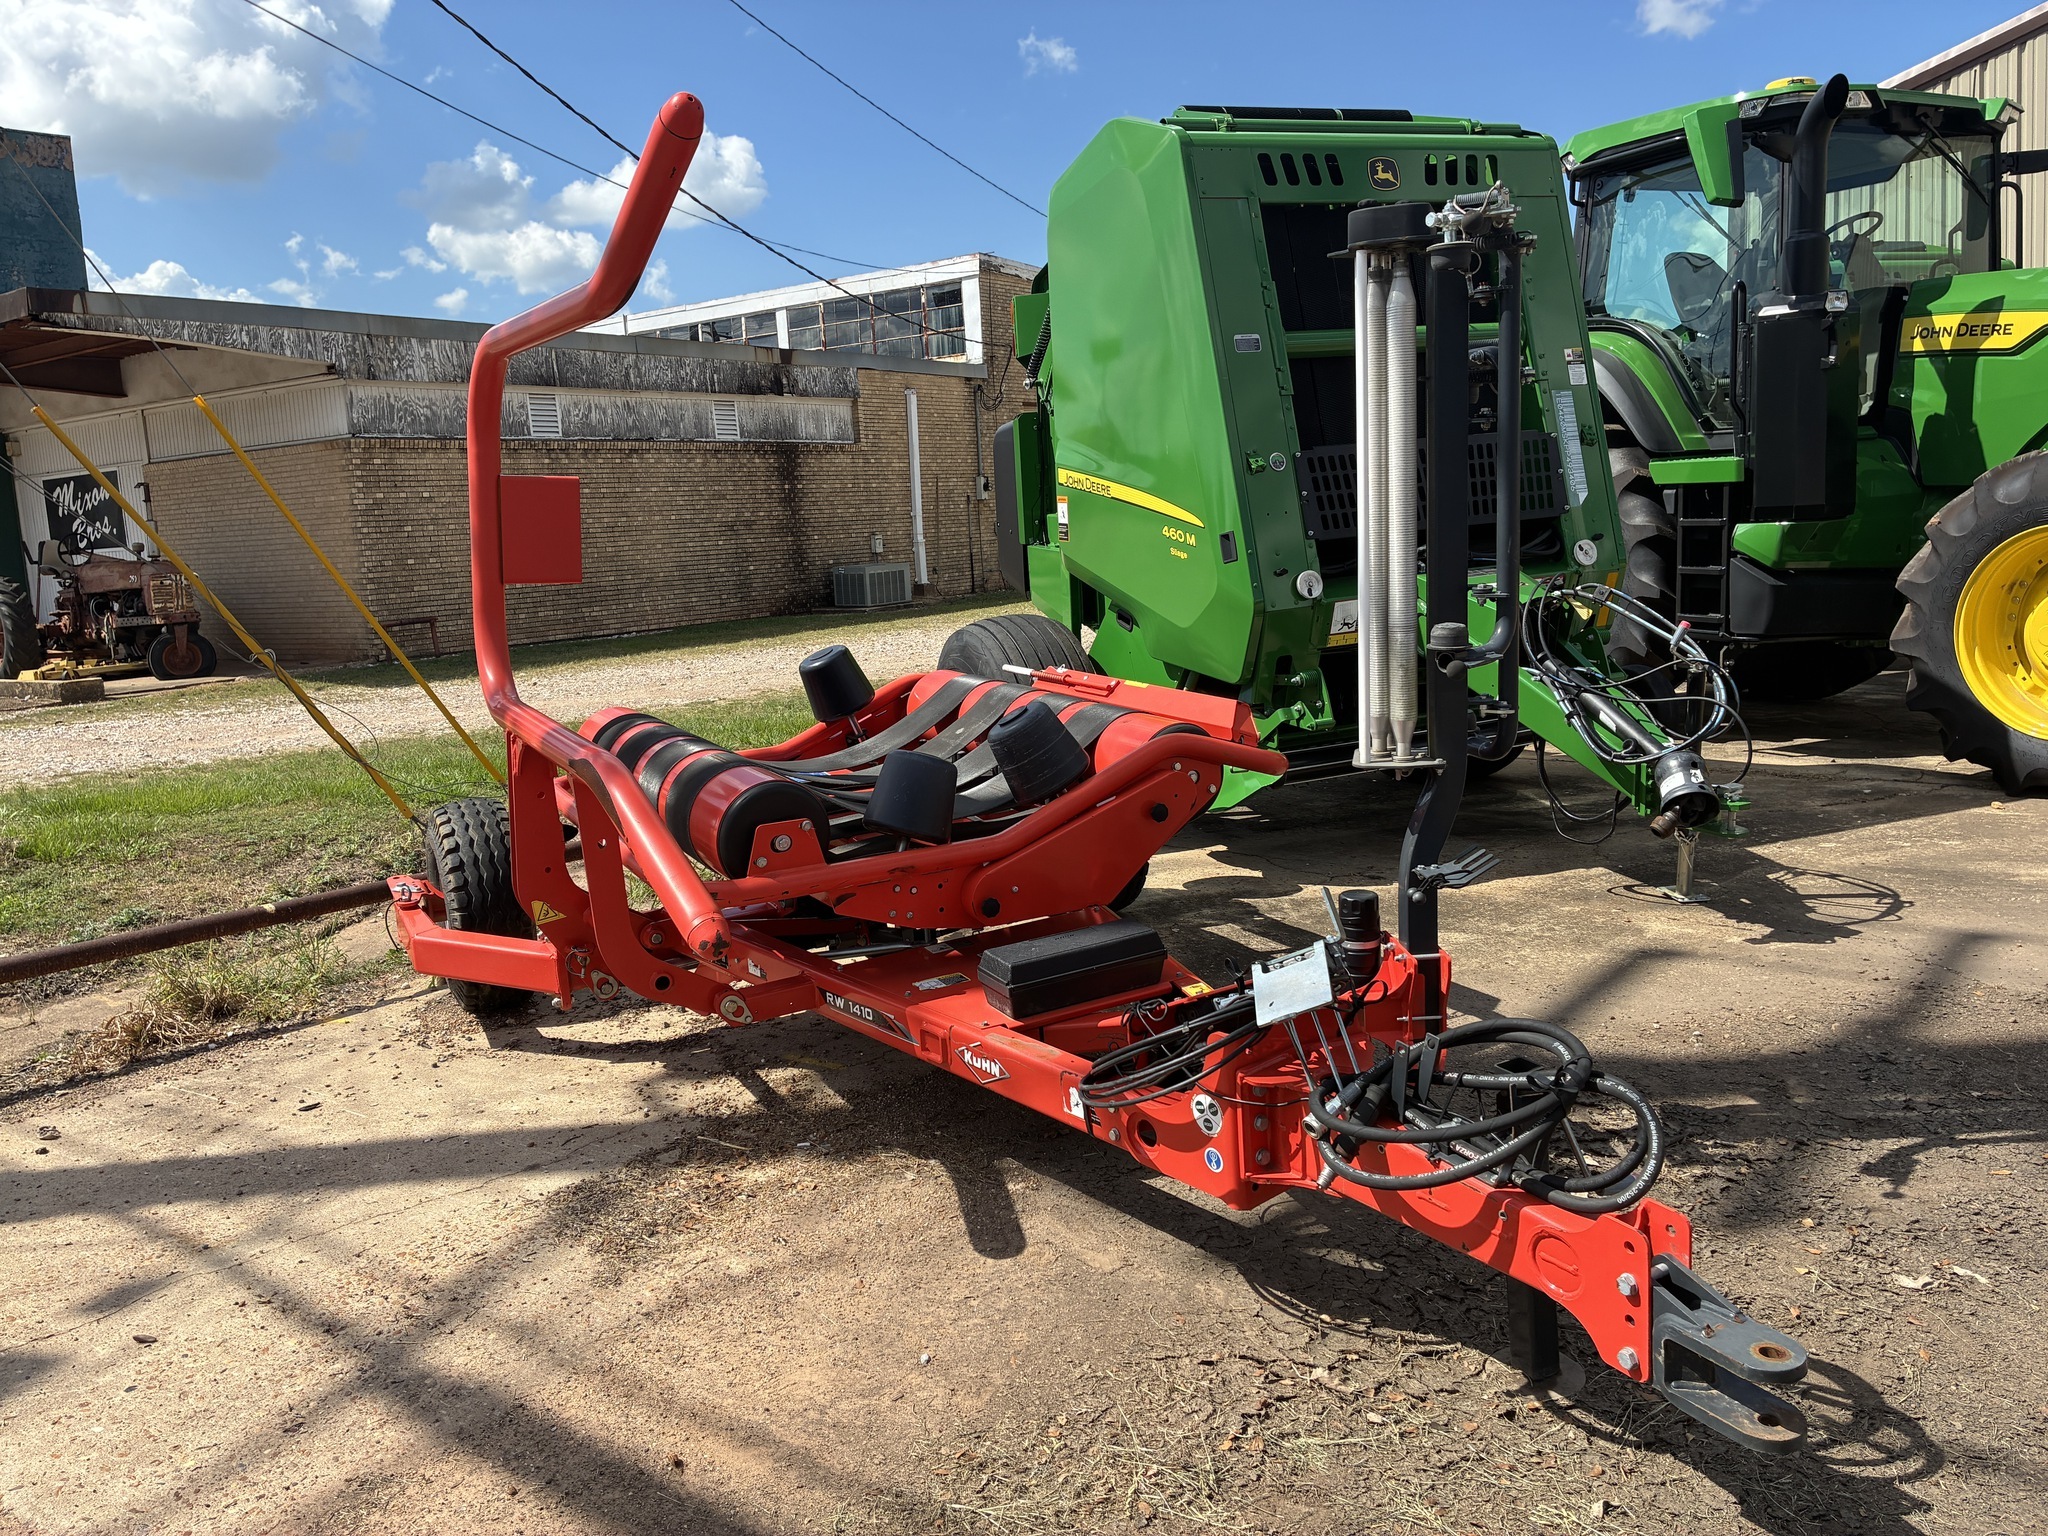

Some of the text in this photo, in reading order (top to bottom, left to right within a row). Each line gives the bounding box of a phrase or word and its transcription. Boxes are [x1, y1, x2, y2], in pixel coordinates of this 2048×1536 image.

[1910, 323, 2014, 340] JOHN DEERE
[1063, 473, 1112, 496] JOHN DEERE
[53, 480, 110, 517] Mixon
[72, 515, 117, 548] Bros.
[1162, 525, 1196, 547] 460 M
[1170, 547, 1188, 559] Silage
[825, 992, 873, 1021] RW 1410
[963, 1049, 1000, 1077] KUHN
[1639, 1102, 1653, 1120] Flame
[1649, 1120, 1660, 1154] Resistant
[1641, 1159, 1657, 1181] MSHA
